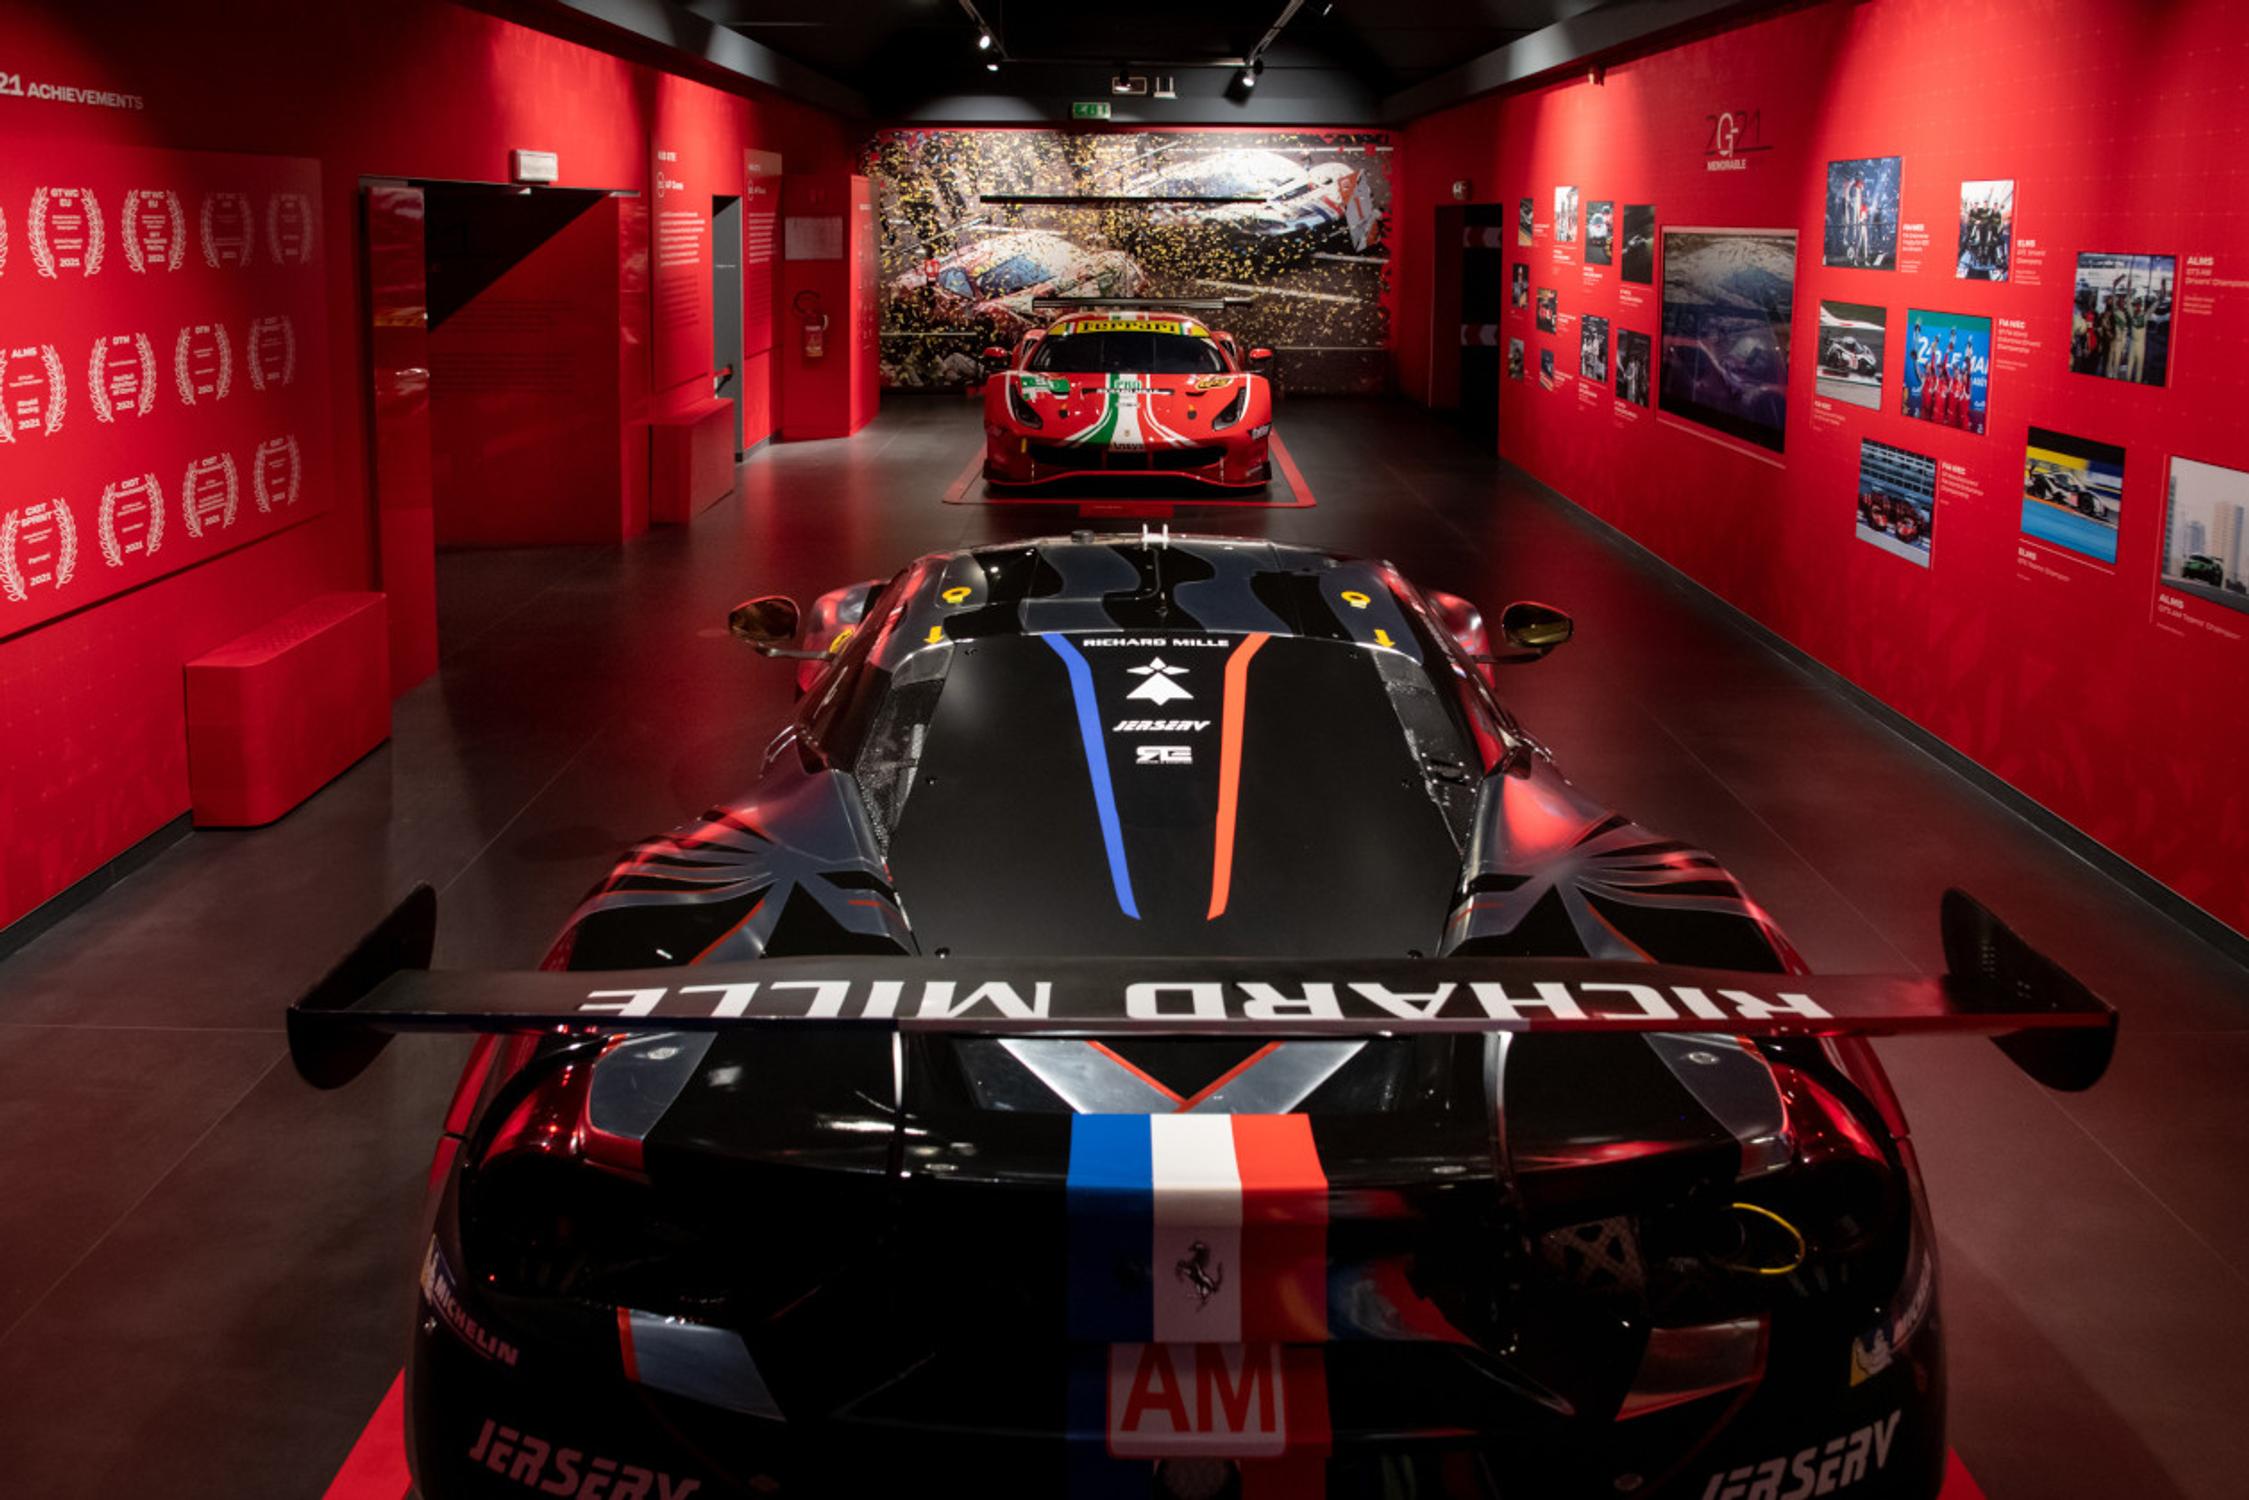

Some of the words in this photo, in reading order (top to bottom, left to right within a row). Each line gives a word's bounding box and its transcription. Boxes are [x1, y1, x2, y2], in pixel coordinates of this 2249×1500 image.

[27, 82, 144, 110] ACHIEVEMENTS
[2186, 256, 2215, 266] ALMS
[1083, 321, 1175, 332] Ferrari
[2159, 594, 2184, 609] ALMS
[1083, 638, 1167, 647] RICHARD
[1172, 638, 1230, 647] MILLE
[1112, 720, 1211, 732] JERSERV
[577, 980, 1053, 1019] MILLE
[1125, 981, 1832, 1020] RICHARD
[433, 1273, 519, 1367] MICHELIN
[1120, 1342, 1277, 1434] AM
[468, 1418, 701, 1500] JERSERV
